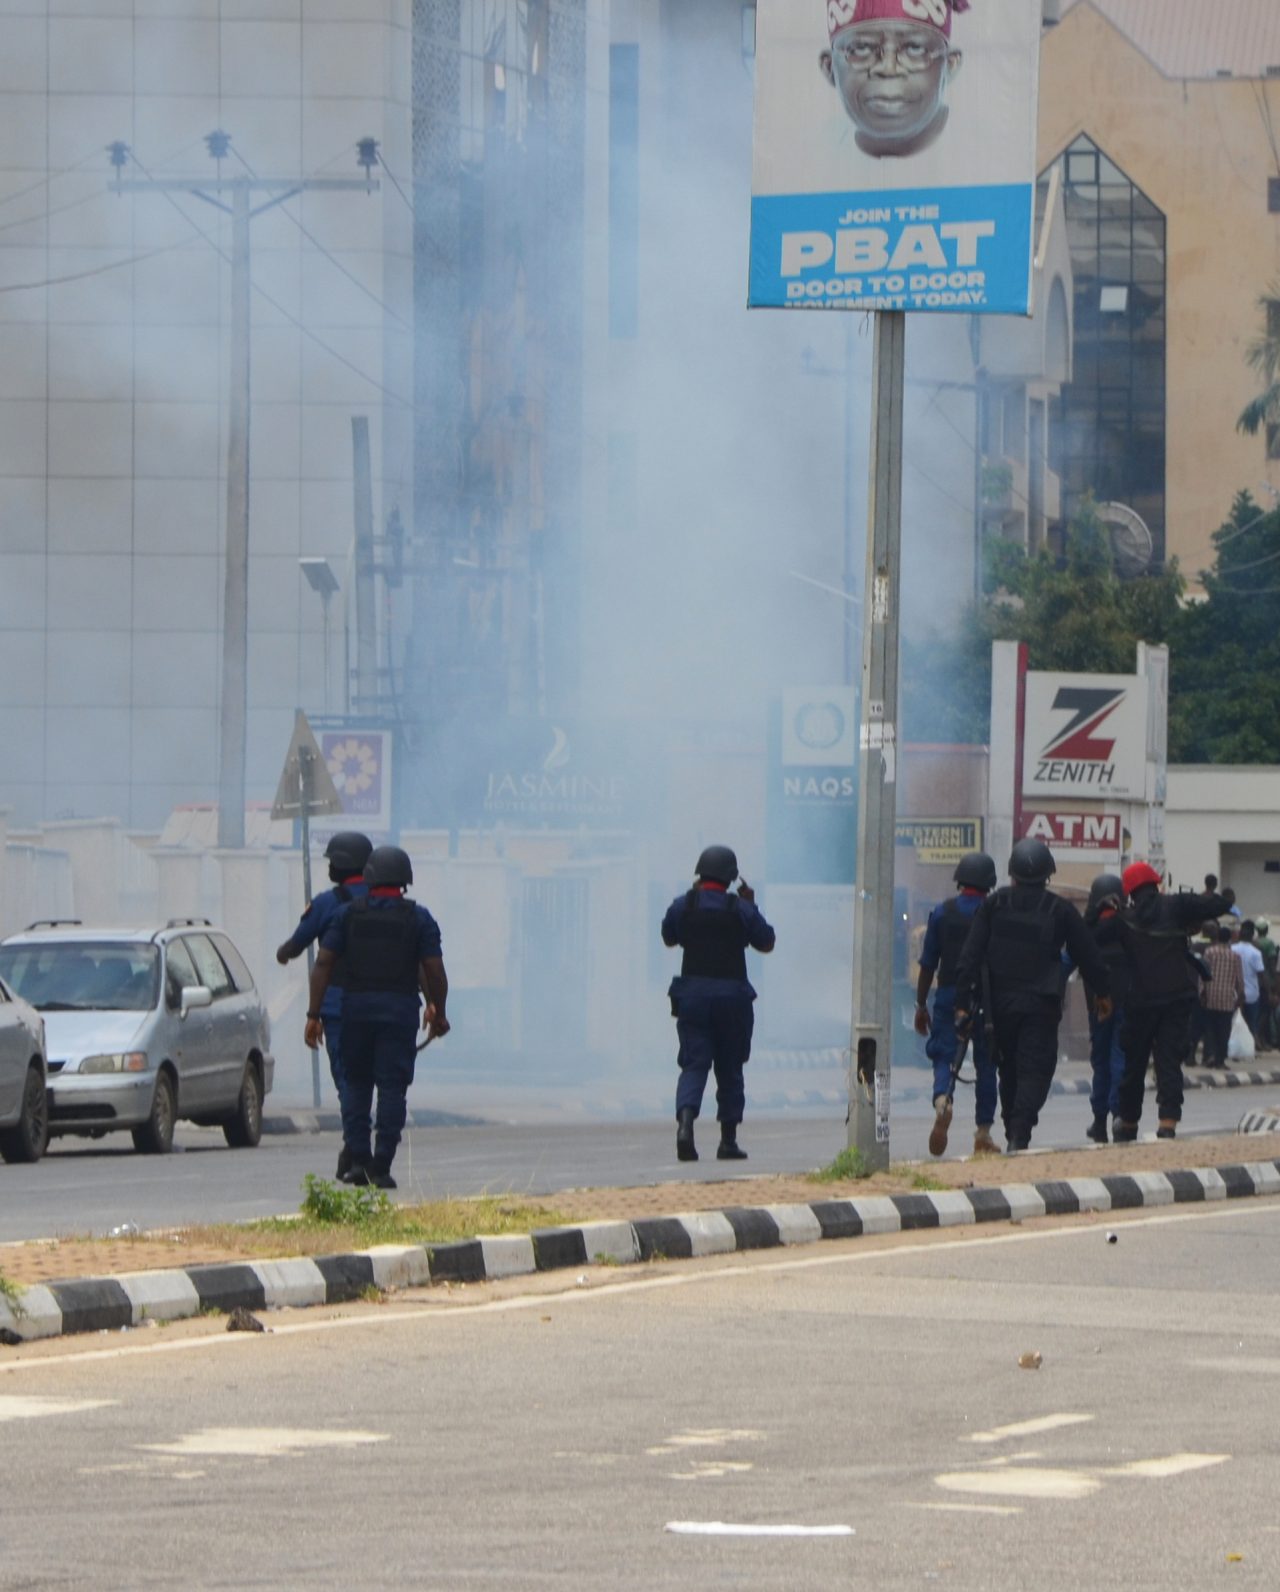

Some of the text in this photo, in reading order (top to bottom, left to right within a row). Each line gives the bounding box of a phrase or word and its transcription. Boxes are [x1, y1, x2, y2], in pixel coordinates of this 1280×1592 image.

[839, 205, 939, 225] JOIN THE
[780, 221, 996, 277] PBAT
[787, 271, 985, 298] DOOR TO DOOR
[487, 771, 625, 800] JASMINE
[1033, 761, 1115, 783] ZENITH
[1025, 814, 1117, 841] ATM
